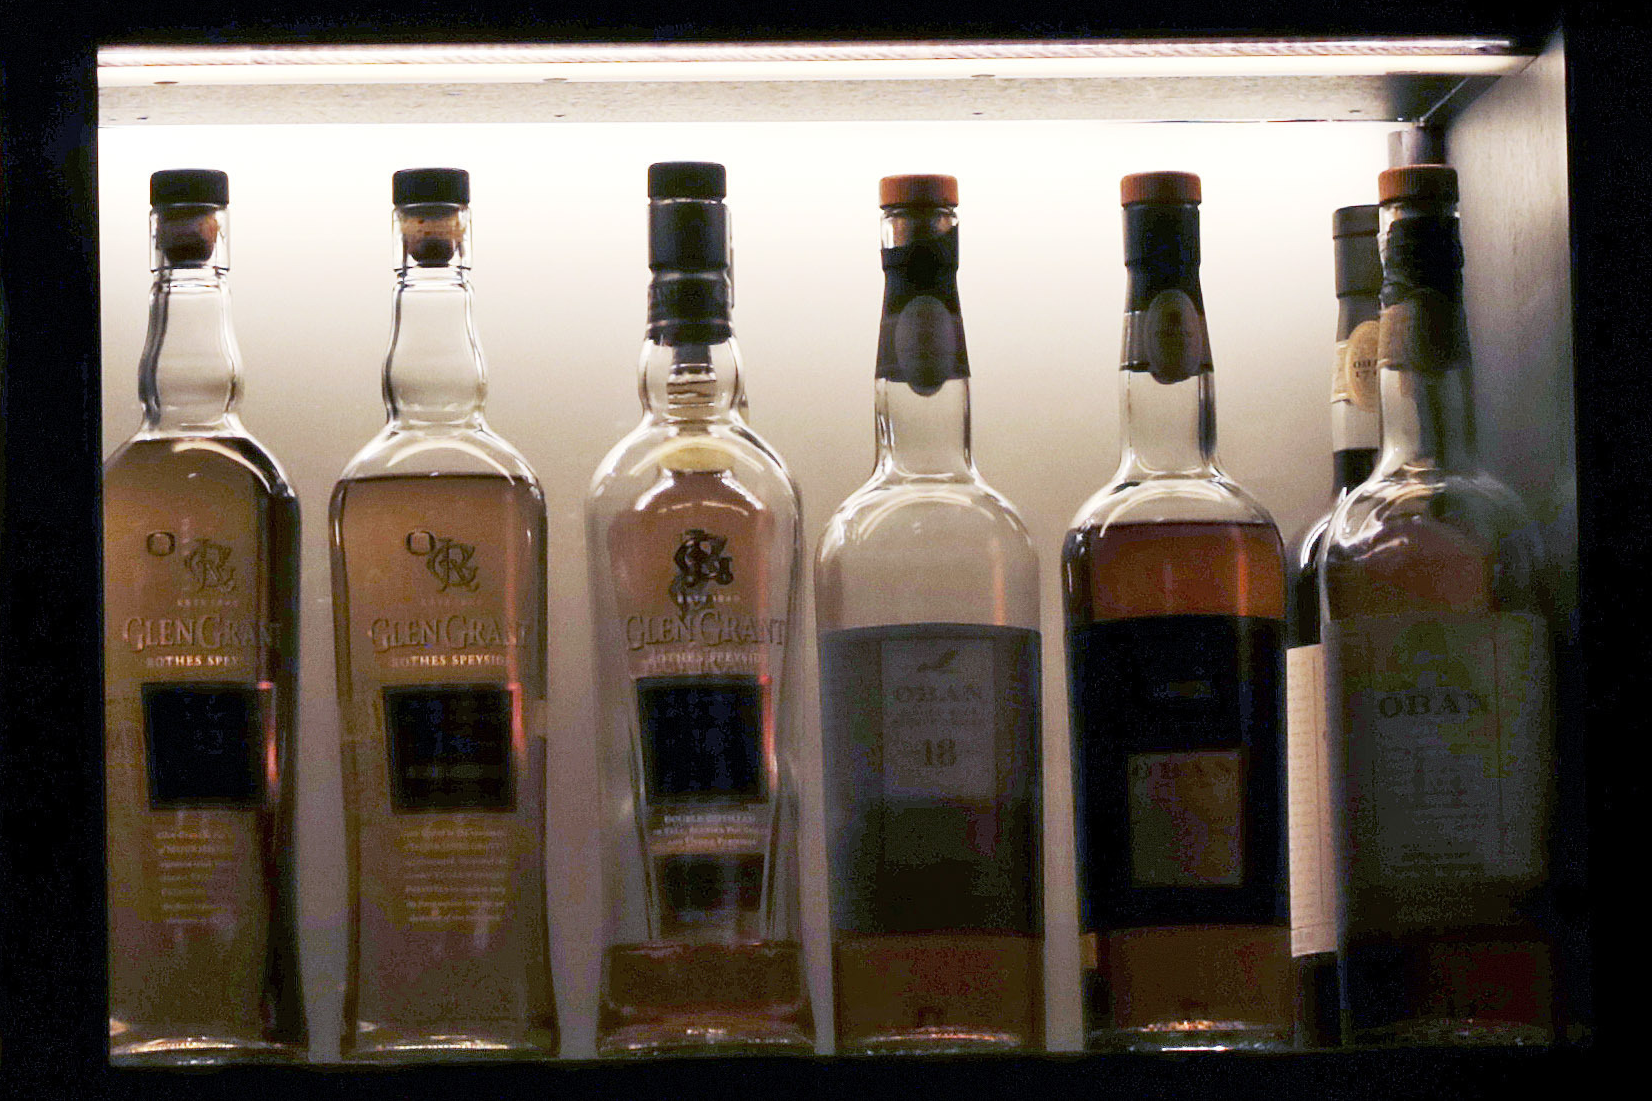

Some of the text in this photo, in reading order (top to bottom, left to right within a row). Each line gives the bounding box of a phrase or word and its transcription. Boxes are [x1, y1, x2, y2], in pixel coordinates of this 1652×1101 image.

[893, 684, 984, 704] OBAN
[1378, 693, 1491, 719] OBAN
[923, 738, 958, 767] 18
